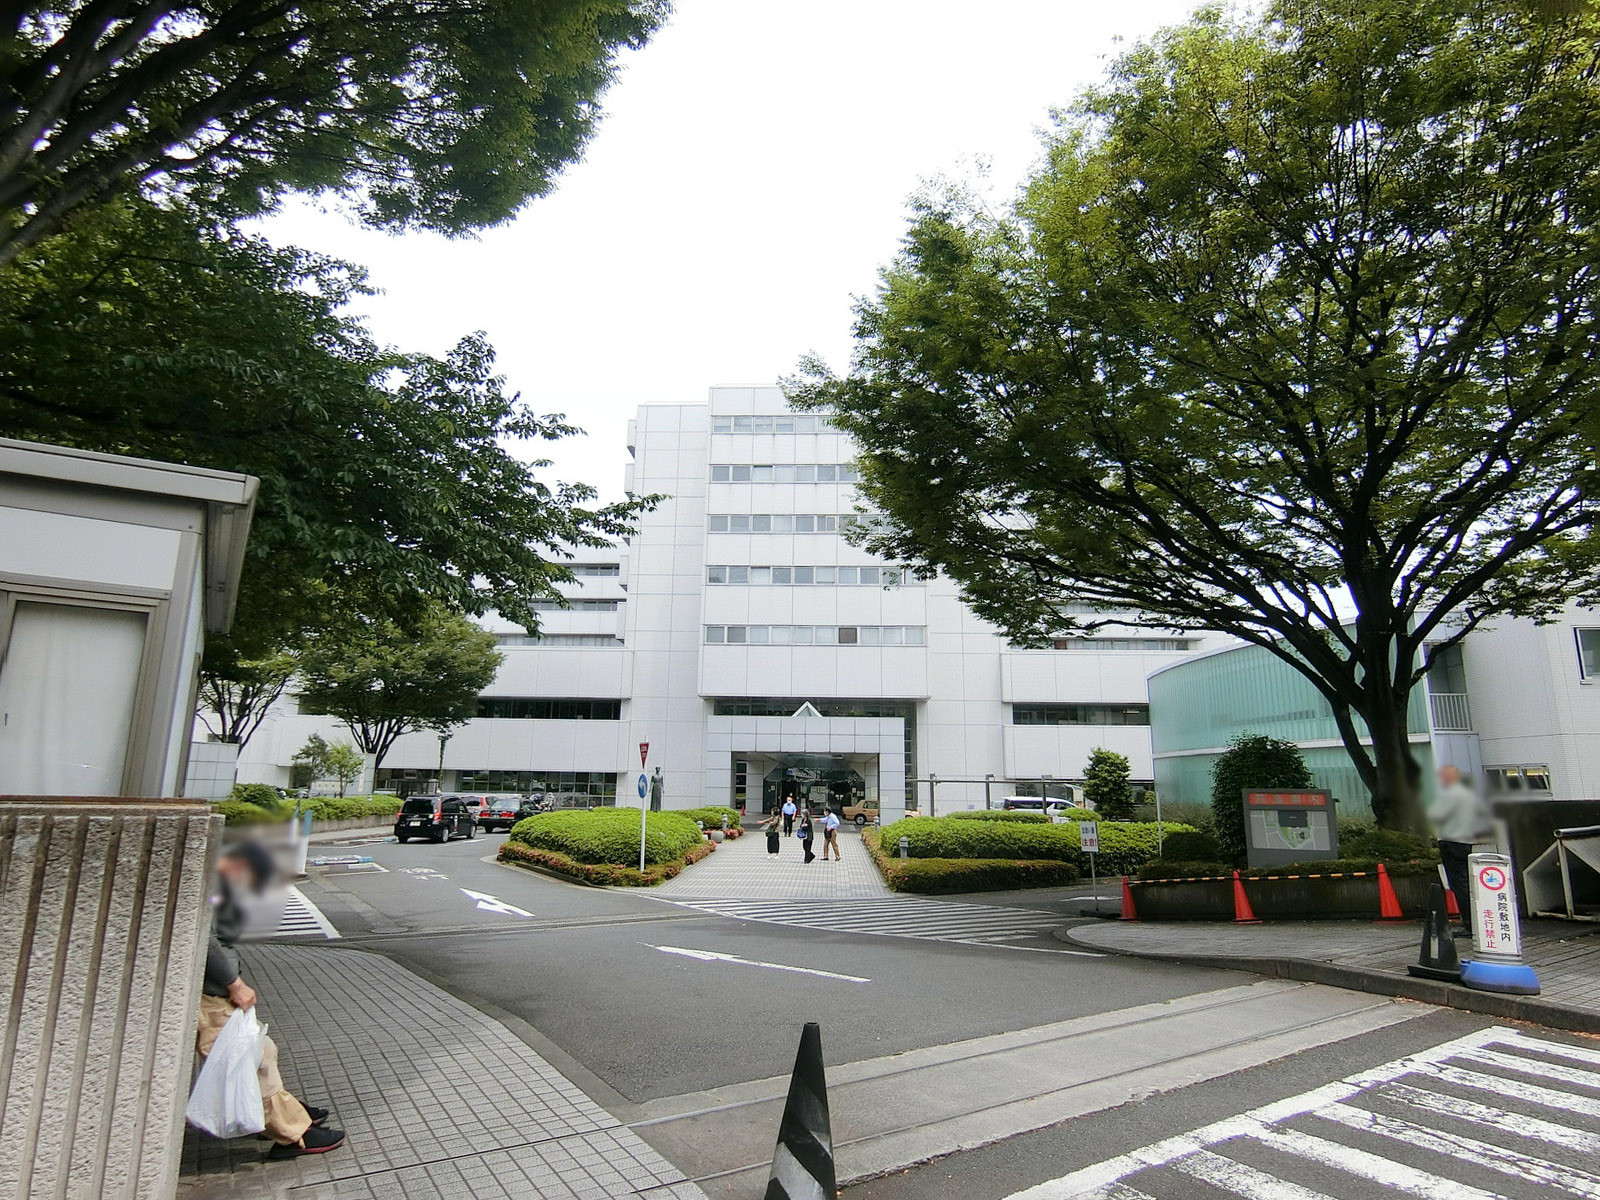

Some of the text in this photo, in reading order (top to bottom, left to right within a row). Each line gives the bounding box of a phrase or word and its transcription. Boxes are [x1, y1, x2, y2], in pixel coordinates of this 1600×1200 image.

[1483, 909, 1497, 949] 走行禁止
[1497, 892, 1511, 942] 病院敷地内
